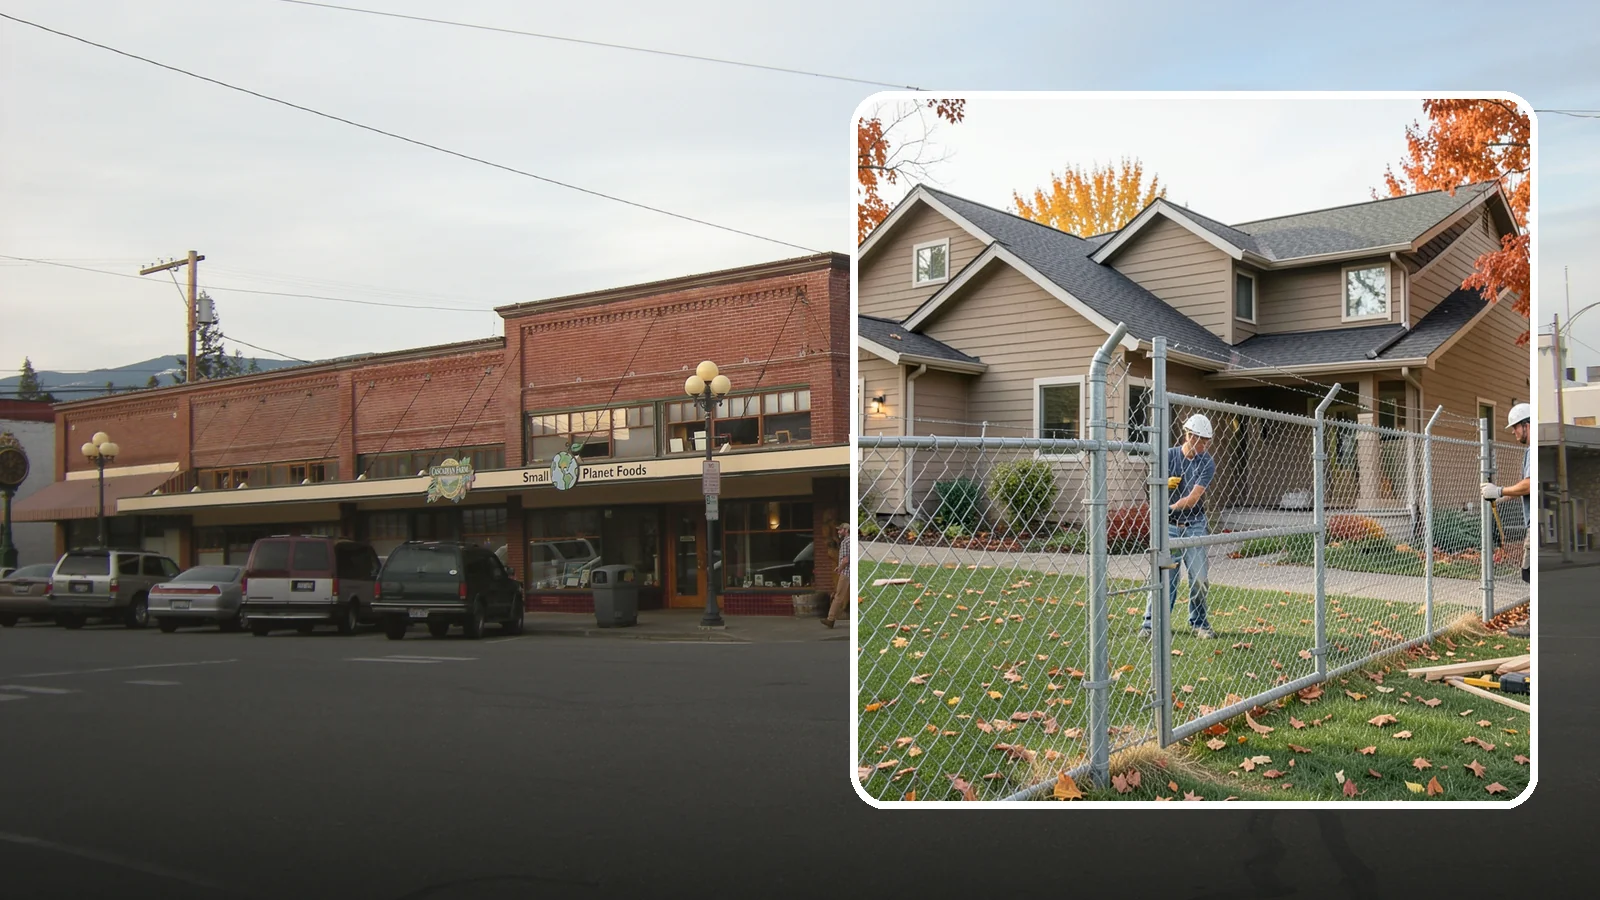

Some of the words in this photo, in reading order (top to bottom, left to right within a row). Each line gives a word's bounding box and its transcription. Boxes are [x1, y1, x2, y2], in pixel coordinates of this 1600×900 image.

[523, 471, 549, 483] Small
[583, 467, 614, 479] Planet
[617, 464, 647, 476] Foods
